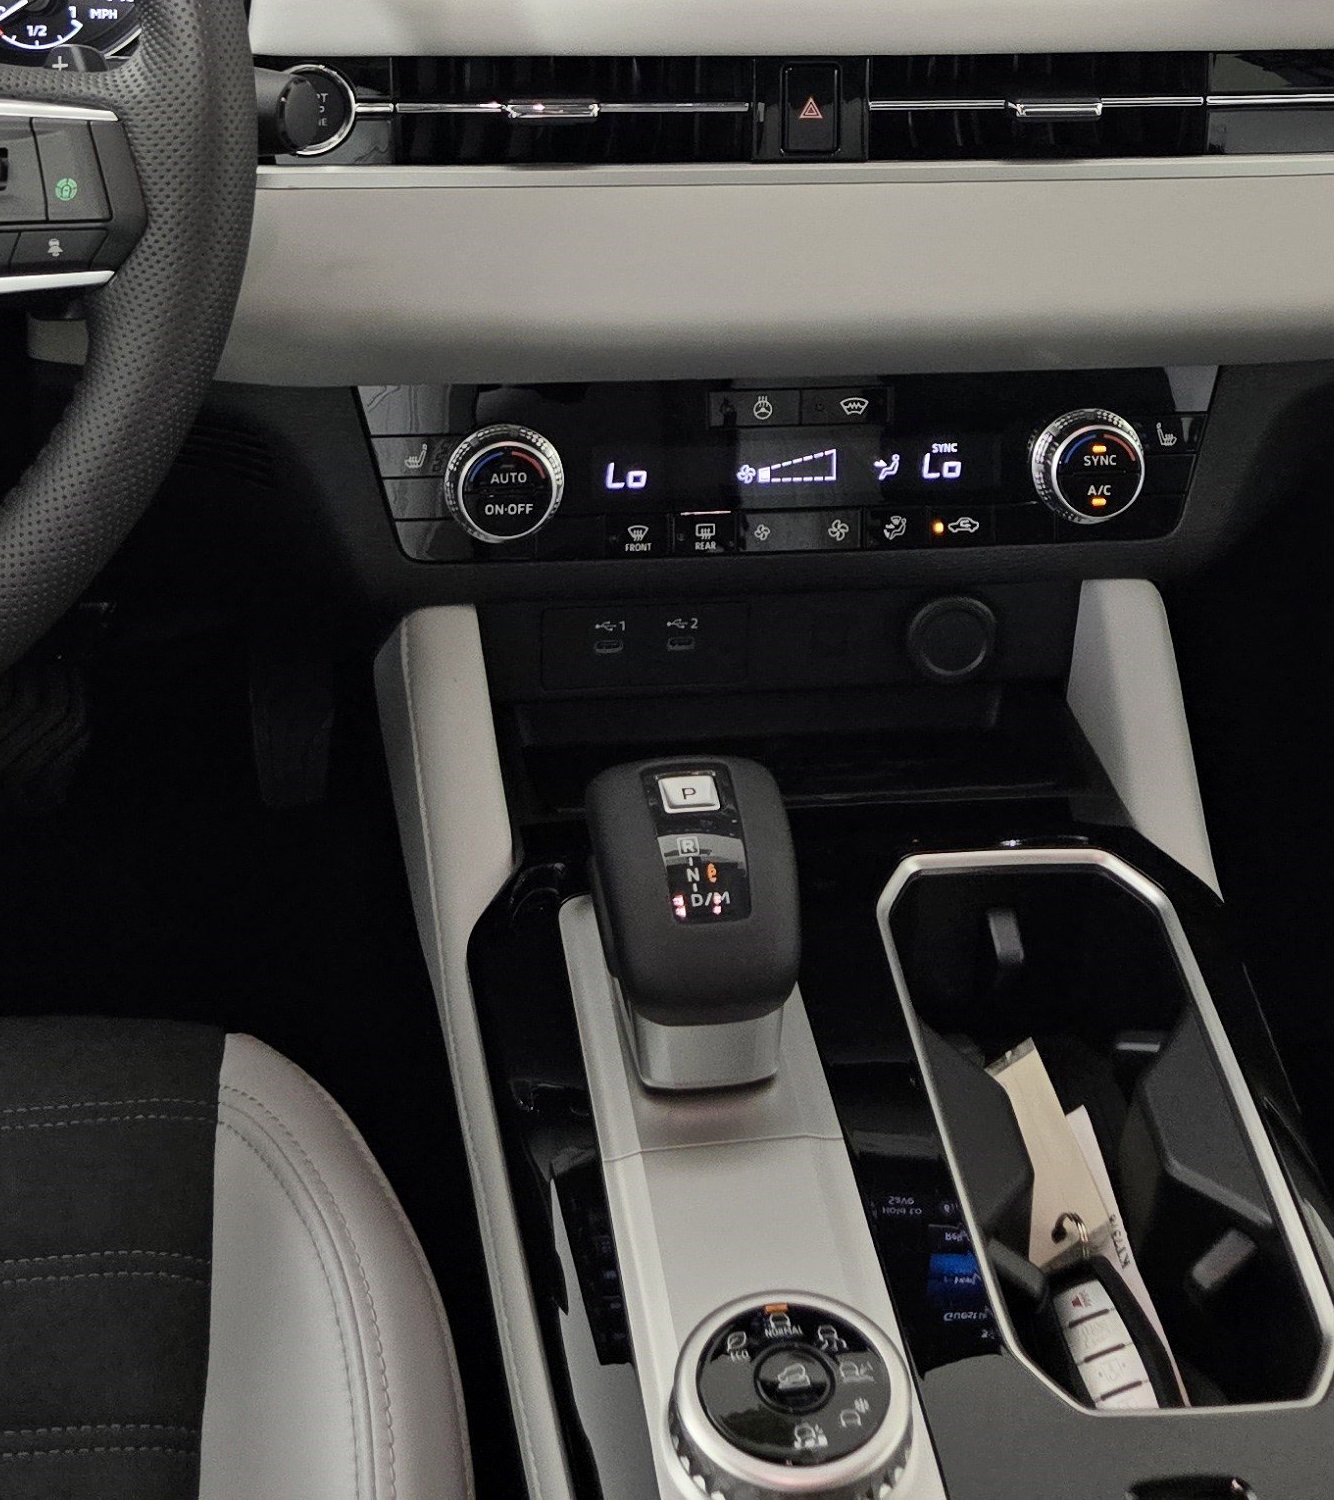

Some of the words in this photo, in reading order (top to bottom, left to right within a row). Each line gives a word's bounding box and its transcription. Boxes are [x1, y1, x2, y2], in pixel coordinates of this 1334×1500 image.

[89, 8, 119, 20] MPH
[26, 25, 48, 37] 1/2
[932, 443, 958, 453] SYNC
[922, 453, 962, 479] Lo
[1083, 455, 1117, 467] SYNC
[490, 472, 527, 484] AUTO
[605, 461, 648, 489] Lo
[1087, 485, 1112, 496] A/C
[625, 543, 652, 552] FRONT
[695, 541, 716, 550] REAR
[618, 620, 626, 632] 1
[690, 618, 698, 629] 2
[682, 787, 697, 800] P
[683, 839, 696, 852] R
[686, 868, 700, 882] N
[765, 1325, 803, 1338] NORMAL
[729, 1350, 750, 1362] ECO
